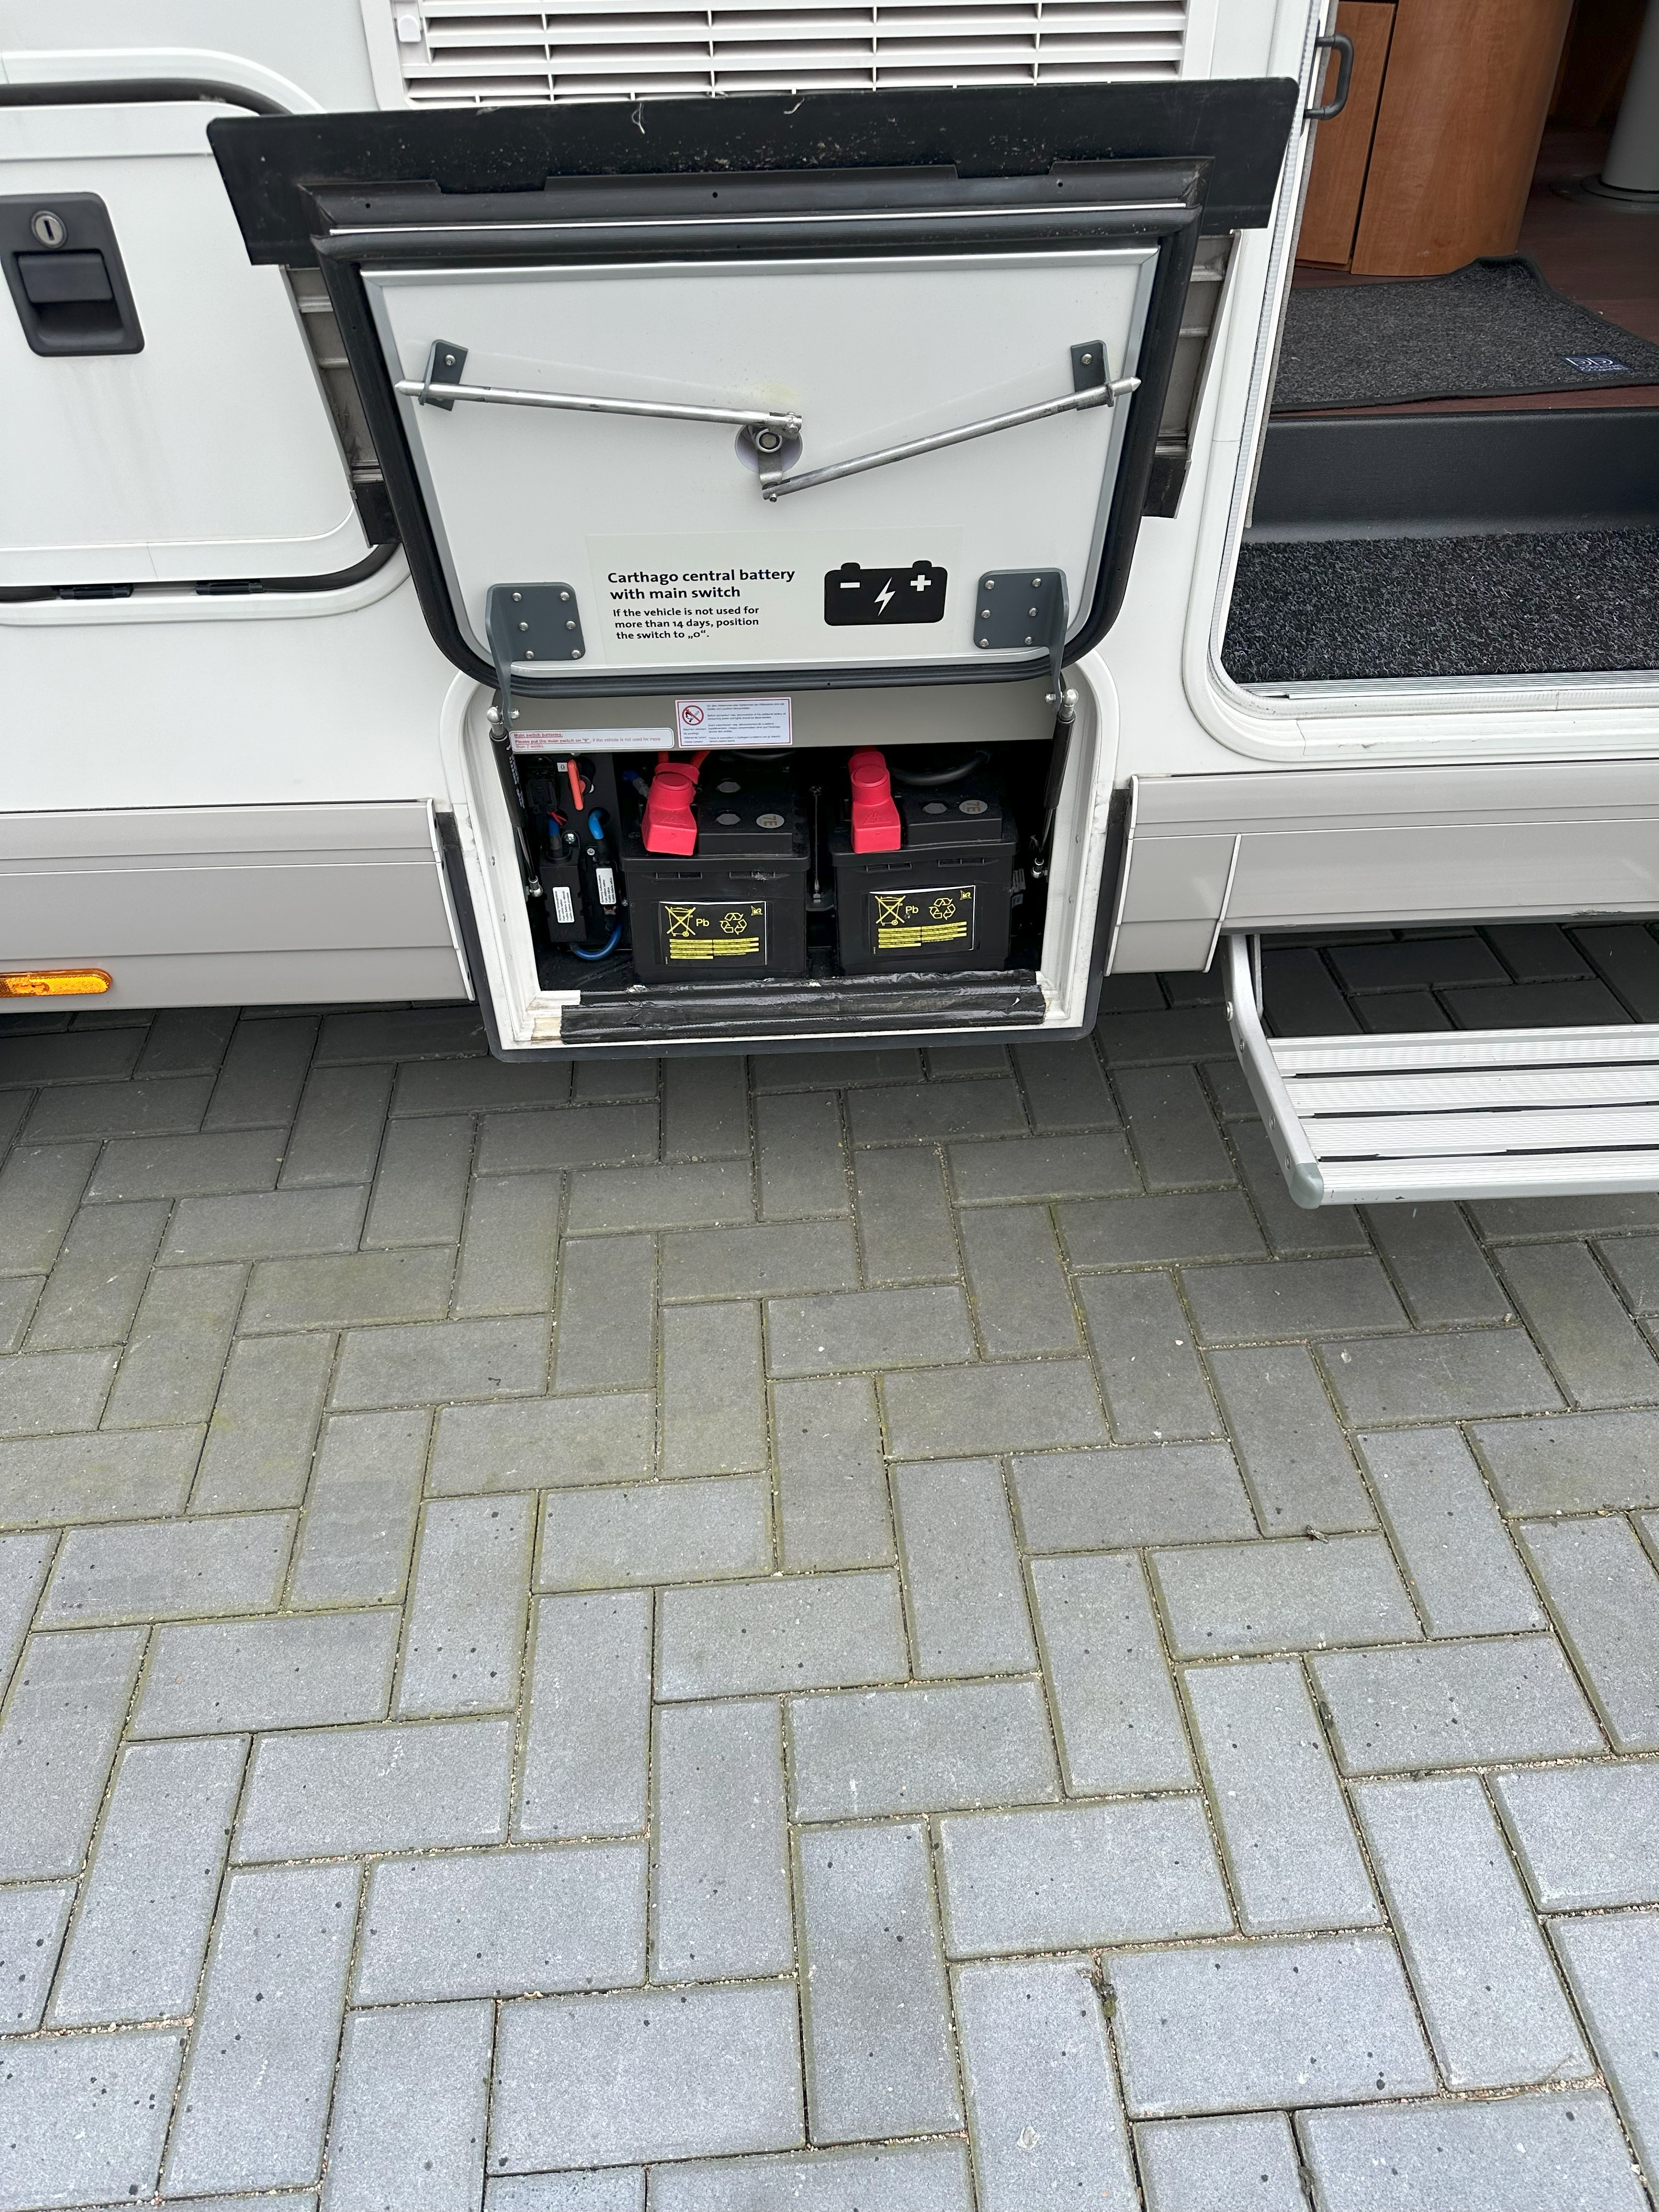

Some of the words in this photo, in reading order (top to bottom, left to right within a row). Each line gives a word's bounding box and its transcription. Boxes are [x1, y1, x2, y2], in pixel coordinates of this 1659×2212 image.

[608, 571, 679, 585] Carthago
[682, 569, 735, 582] central
[740, 569, 795, 583] battery
[610, 588, 645, 600] with
[650, 588, 687, 599] main
[691, 586, 740, 598] switch
[613, 608, 621, 617] If
[623, 608, 641, 617] the
[644, 607, 681, 616] vehicle
[716, 606, 741, 614] used
[743, 606, 759, 614] for
[645, 619, 670, 628] than
[686, 618, 714, 629] days,
[716, 618, 759, 628] position
[636, 630, 671, 639] switch
[905, 906, 919, 914] Pb
[696, 918, 710, 927] Pb
